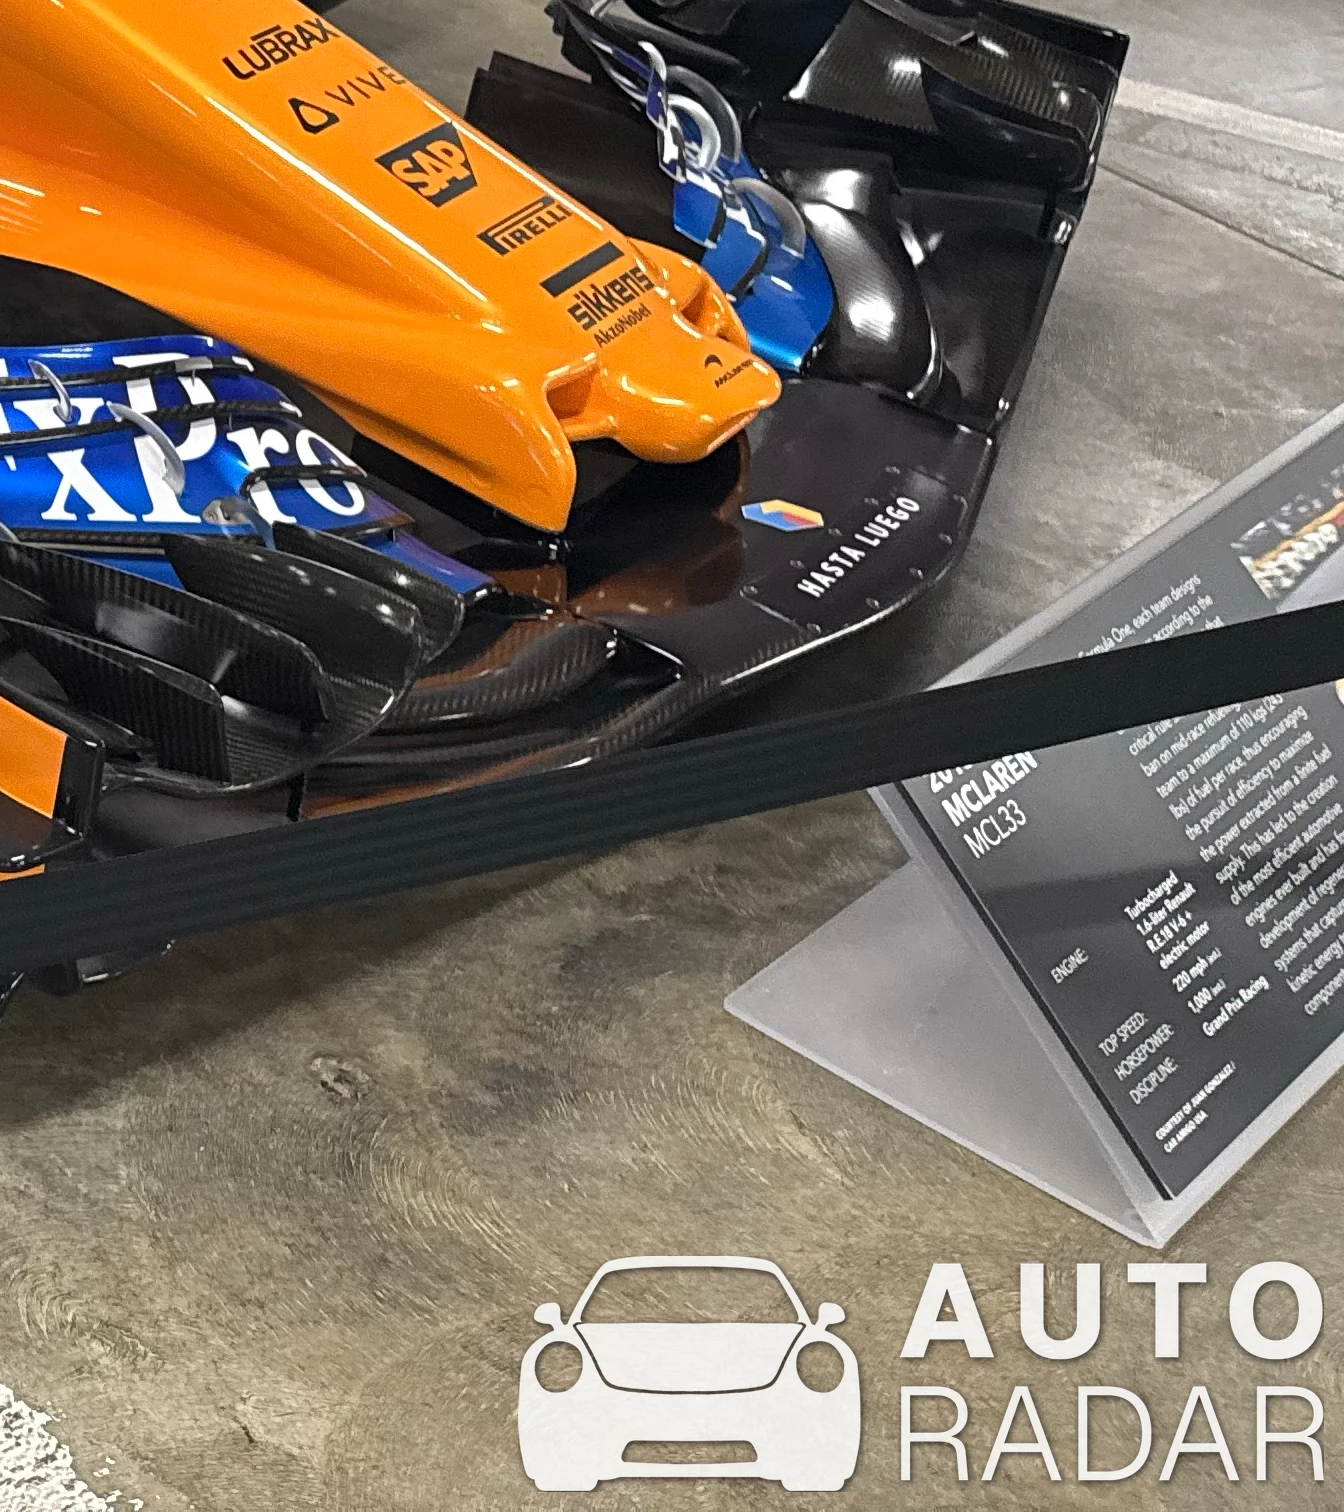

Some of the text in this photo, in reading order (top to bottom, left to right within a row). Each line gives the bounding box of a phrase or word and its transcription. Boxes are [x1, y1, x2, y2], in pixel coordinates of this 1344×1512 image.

[222, 16, 342, 81] LUBRAX
[326, 66, 407, 108] VIVE
[391, 139, 474, 198] SAP
[476, 195, 576, 256] PIRELLI
[567, 265, 656, 332] sikkens
[593, 301, 653, 348] AkzoNobel
[797, 496, 920, 598] HASTA LUEGO
[941, 750, 1038, 827] MCLAREN
[963, 799, 1027, 859] MCL33
